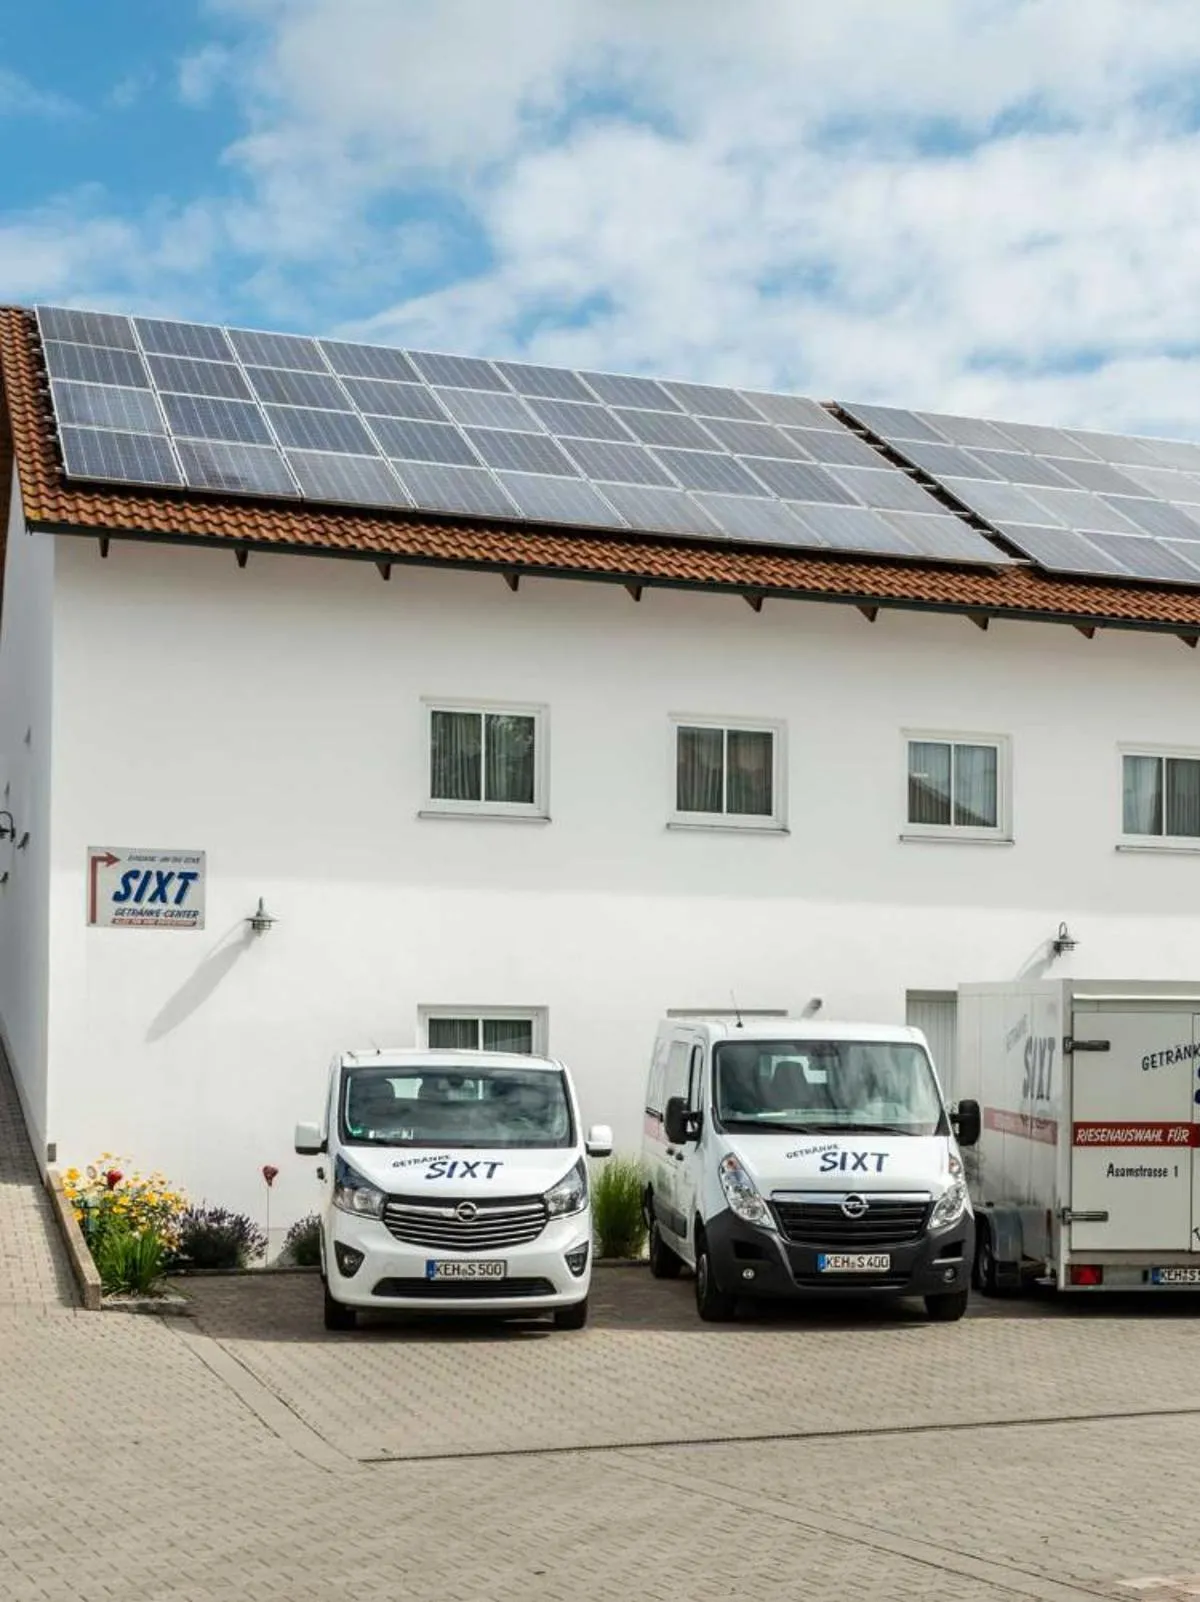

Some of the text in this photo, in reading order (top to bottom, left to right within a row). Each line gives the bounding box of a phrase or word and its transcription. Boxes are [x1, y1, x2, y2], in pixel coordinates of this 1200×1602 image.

[112, 870, 198, 905] SIXT
[1022, 1036, 1056, 1101] SIXT
[1076, 1127, 1164, 1143] RIESENAUSWAHL
[1167, 1126, 1190, 1143] FÜR
[786, 1143, 839, 1159] GETRÄNKE
[392, 1155, 450, 1168] GETRÄNKE
[425, 1161, 504, 1179] SIXT
[820, 1151, 890, 1173] SIXT
[1106, 1162, 1179, 1178] Asamstrasse 1
